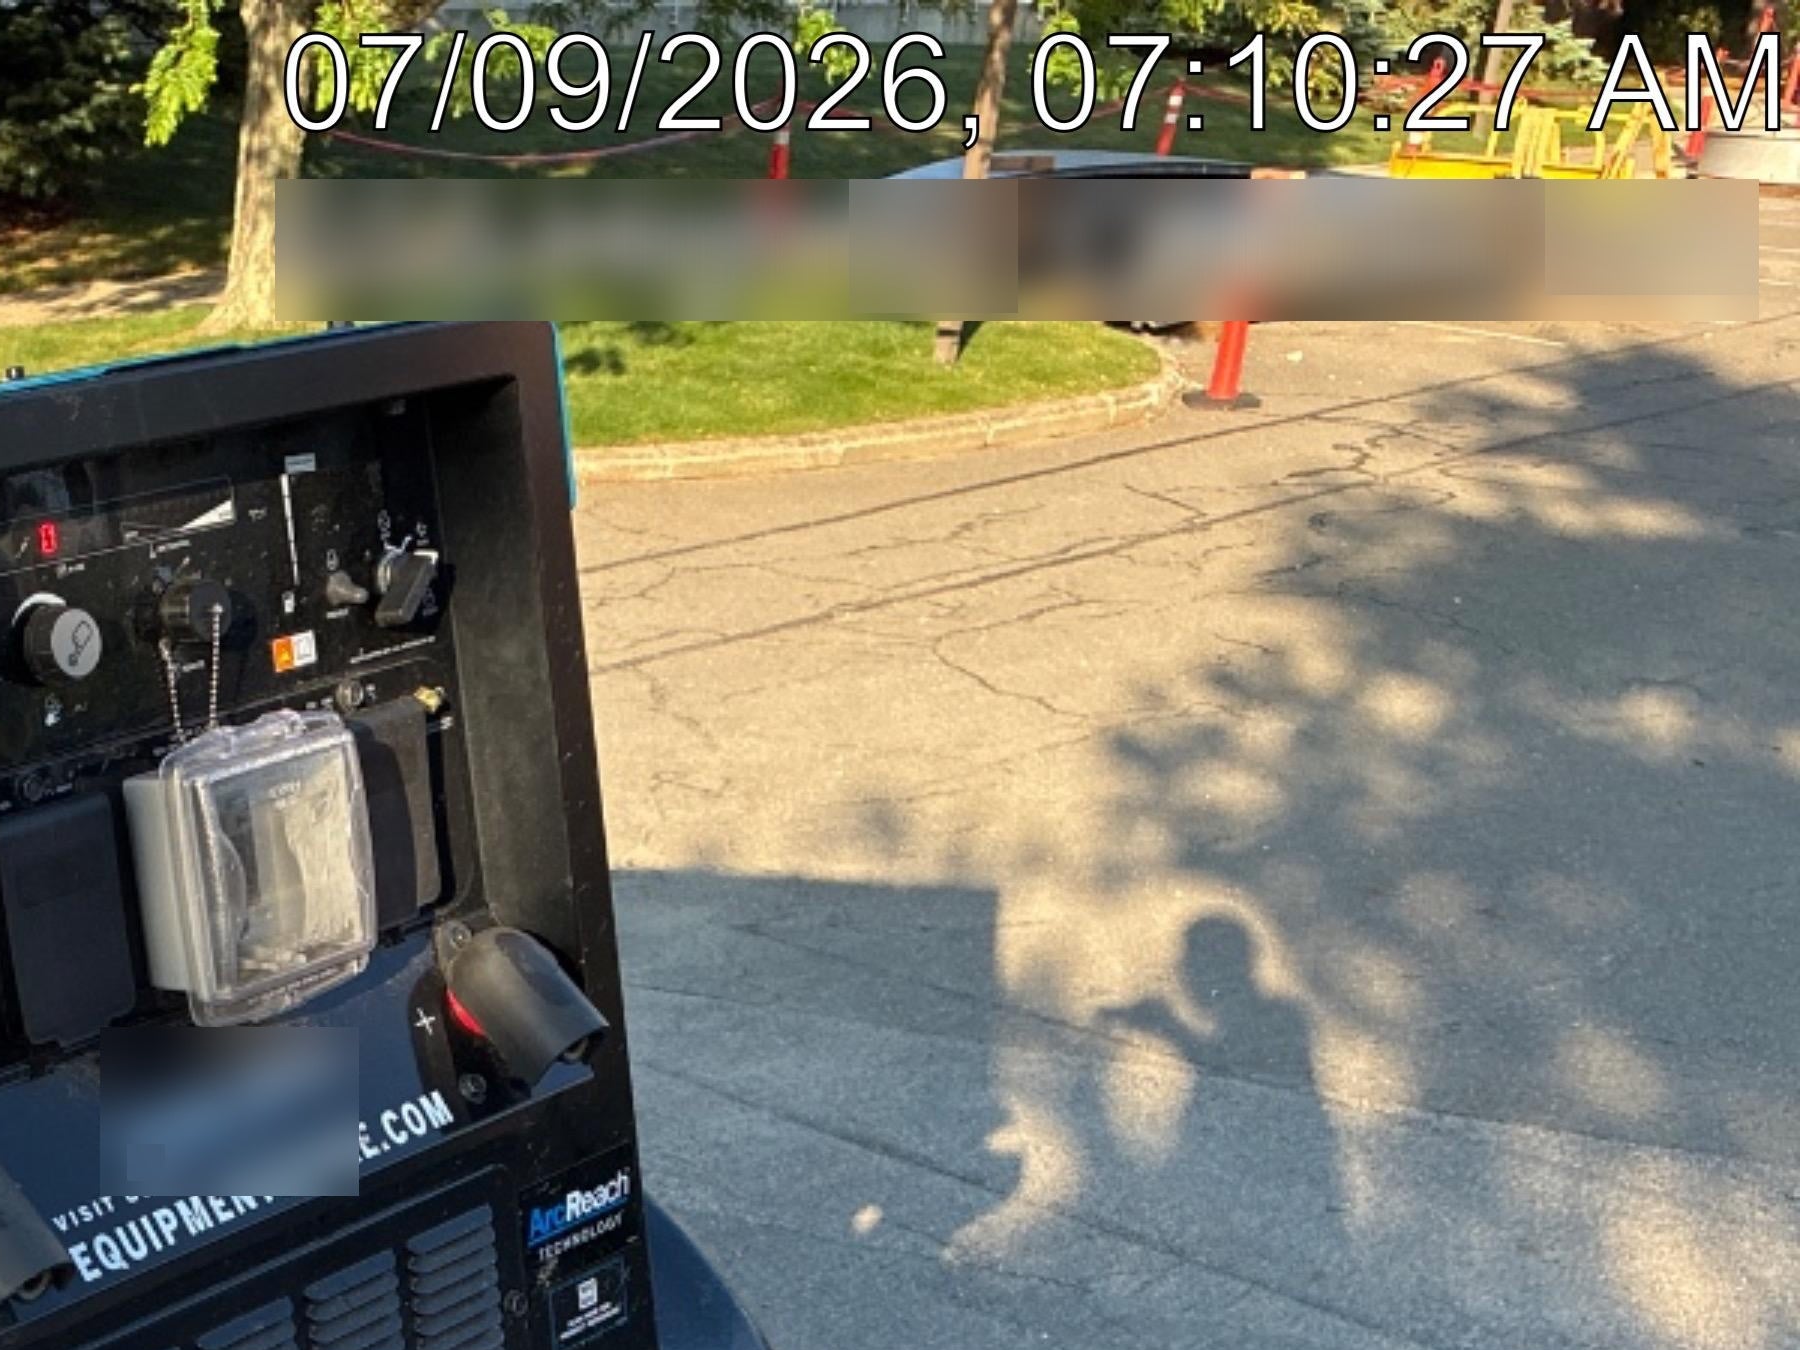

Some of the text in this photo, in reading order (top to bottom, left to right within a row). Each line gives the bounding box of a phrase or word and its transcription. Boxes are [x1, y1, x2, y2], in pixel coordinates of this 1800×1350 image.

[51, 1195, 115, 1232] VISIT
[529, 1172, 631, 1238] ArcReach
[538, 1212, 625, 1262] TECHNOLOGY
